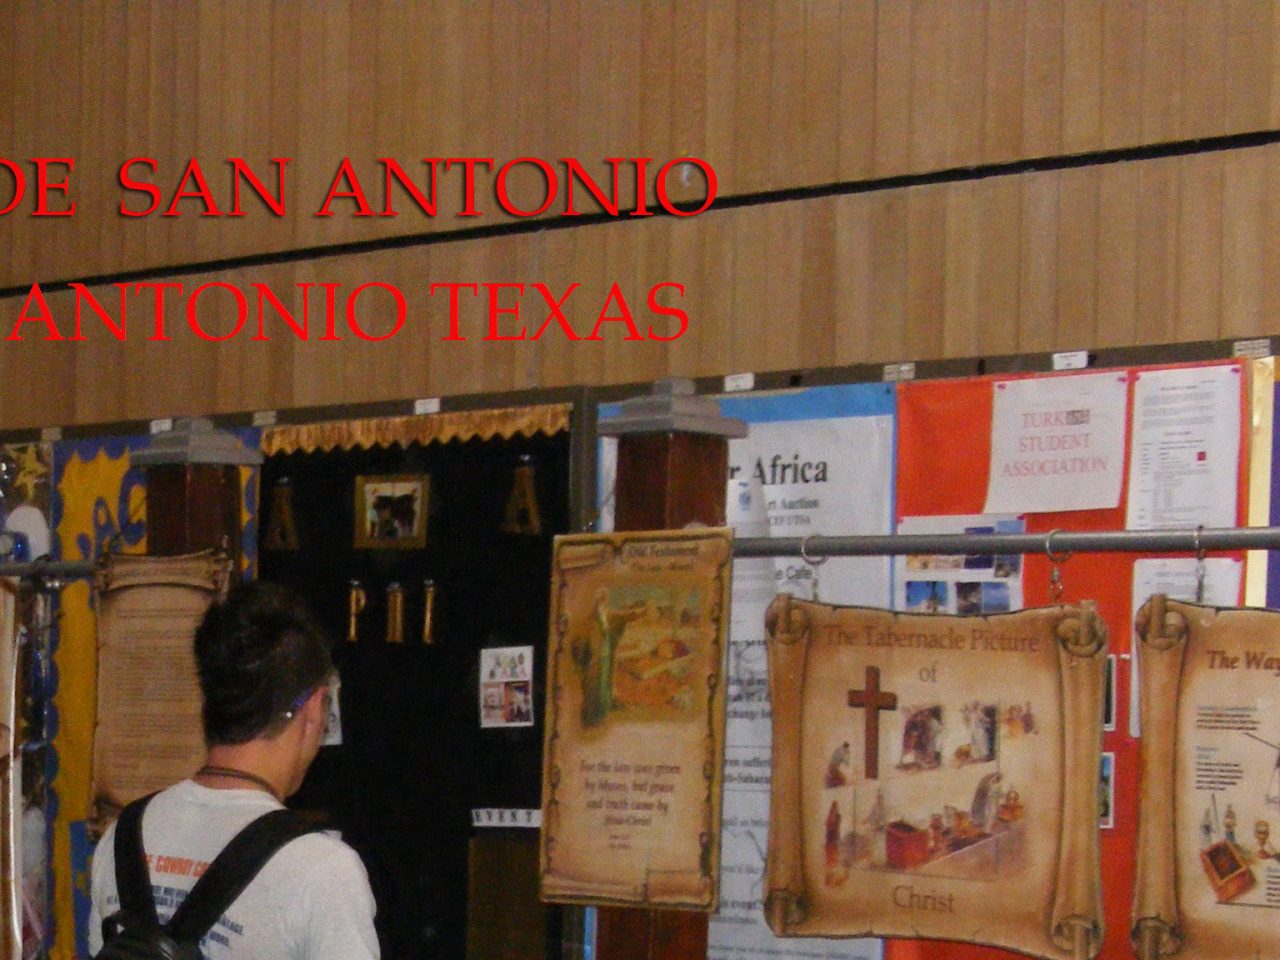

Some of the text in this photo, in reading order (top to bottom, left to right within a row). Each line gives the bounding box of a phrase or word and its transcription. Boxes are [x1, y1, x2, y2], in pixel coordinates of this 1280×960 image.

[1020, 433, 1091, 452] STUDENT
[751, 453, 829, 486] Africa
[1002, 455, 1109, 477] ASSOCIATION
[864, 626, 965, 649] Tabernacle
[972, 629, 1040, 651] Picture
[1208, 651, 1239, 670] The
[893, 885, 955, 912] Christ
